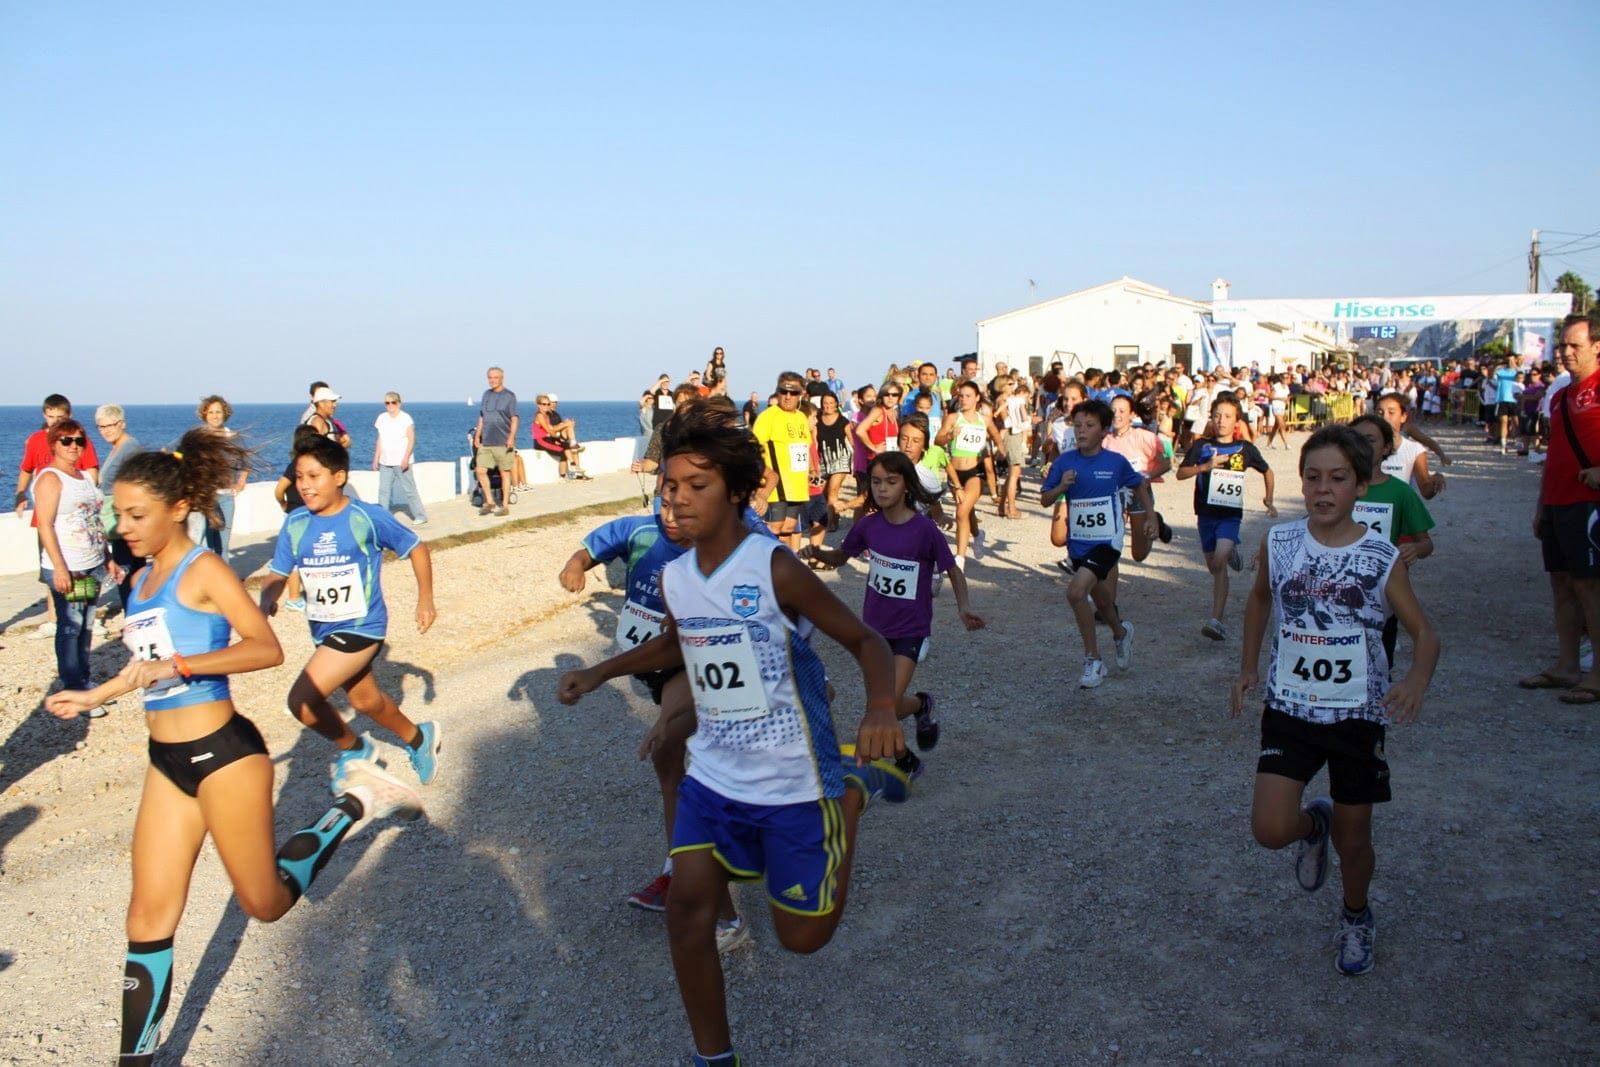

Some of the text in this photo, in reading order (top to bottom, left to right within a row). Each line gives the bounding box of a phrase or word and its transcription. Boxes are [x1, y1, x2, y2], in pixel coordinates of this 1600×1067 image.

[1334, 302, 1435, 317] Hisense
[1371, 327, 1396, 338] 4 62
[963, 434, 981, 443] 430
[1217, 483, 1242, 496] 459
[1072, 500, 1109, 508] INTERSPORT
[1076, 512, 1106, 528] 458
[874, 557, 916, 572] INTERSPORT
[874, 573, 906, 596] 436
[316, 585, 351, 605] 497
[1292, 632, 1361, 646] INTERSPORT
[694, 661, 745, 692] 402
[1292, 655, 1353, 684] 403
